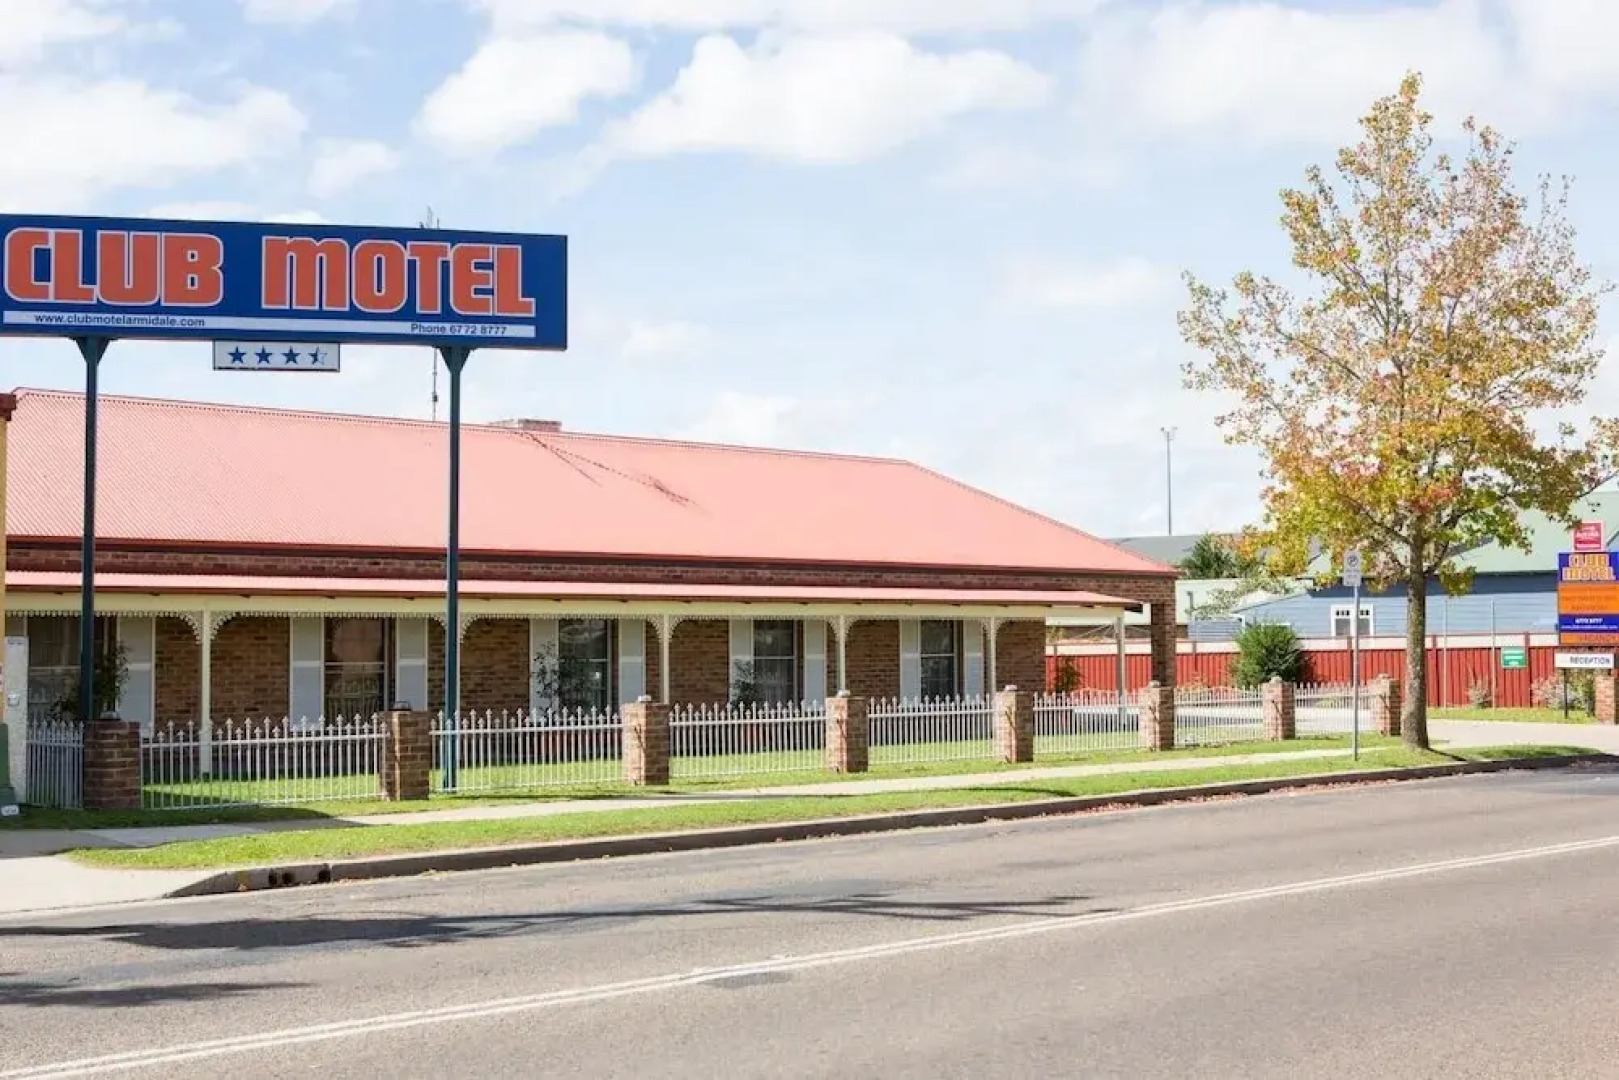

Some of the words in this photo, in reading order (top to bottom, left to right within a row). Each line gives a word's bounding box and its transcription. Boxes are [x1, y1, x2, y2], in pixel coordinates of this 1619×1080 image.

[4, 227, 224, 306] CLUB
[262, 236, 536, 317] MOTEL
[34, 313, 206, 327] www.clubmotelarmidale.com
[410, 323, 447, 335] Phone
[449, 324, 477, 335] 6772
[480, 325, 508, 336] 8777
[1569, 656, 1610, 665] RECEPTION
